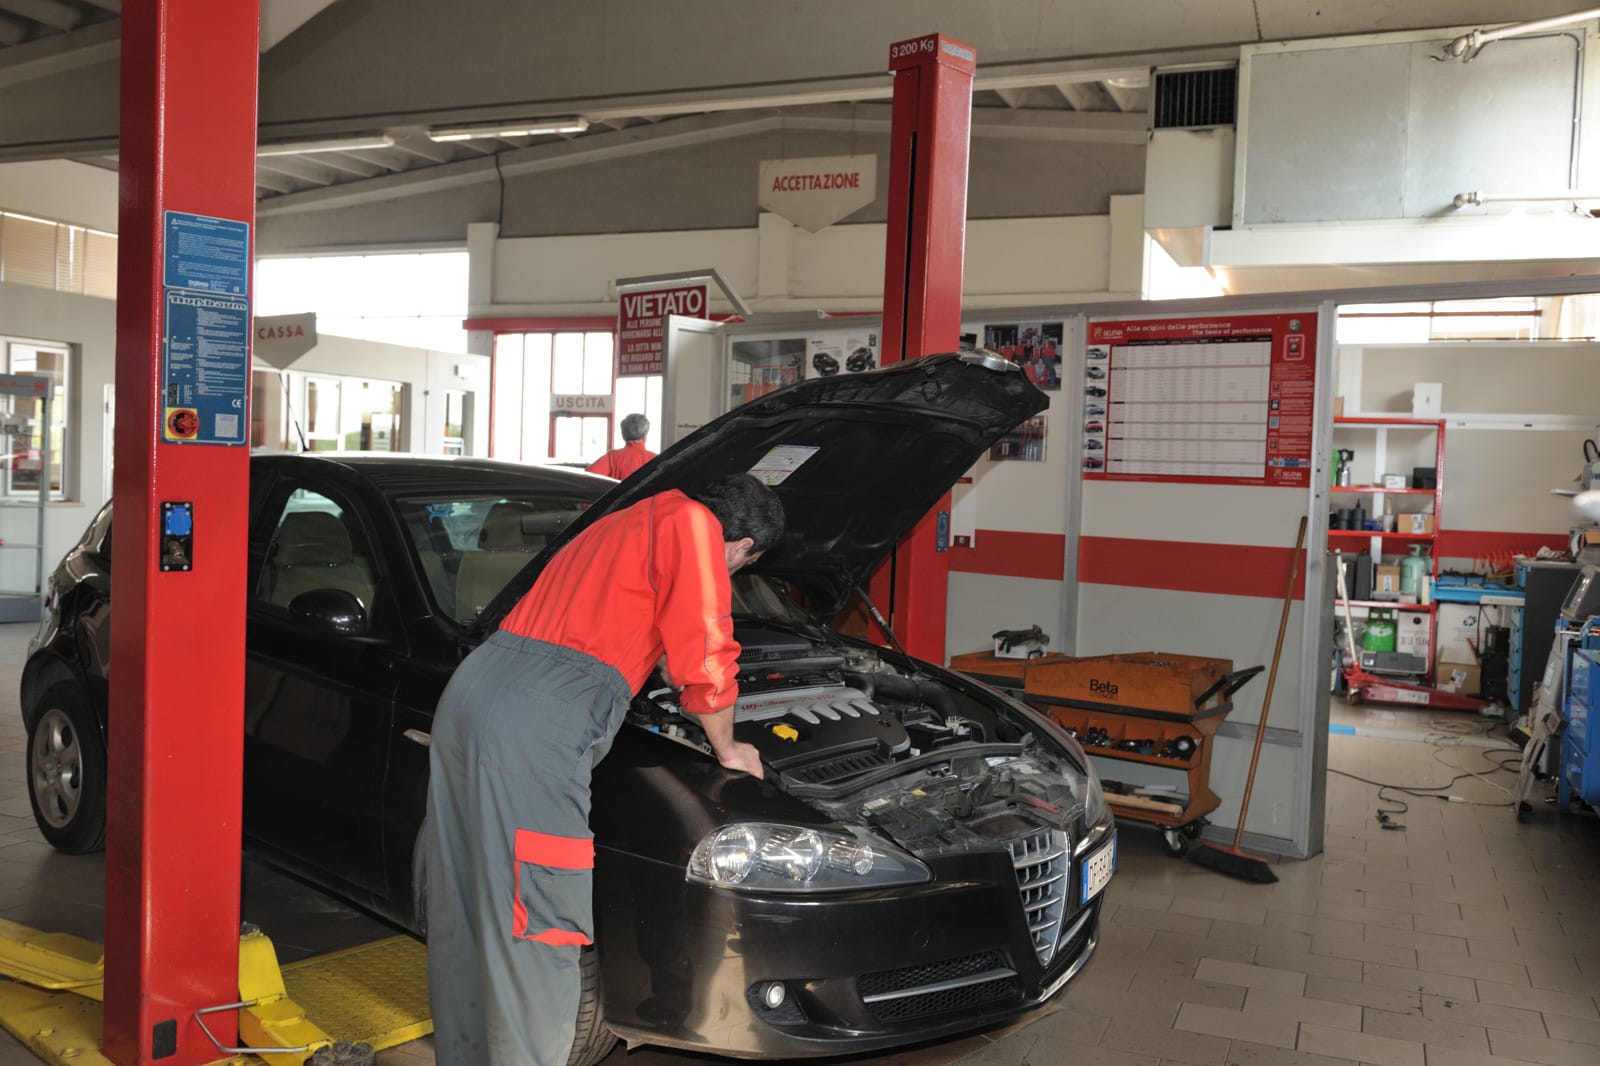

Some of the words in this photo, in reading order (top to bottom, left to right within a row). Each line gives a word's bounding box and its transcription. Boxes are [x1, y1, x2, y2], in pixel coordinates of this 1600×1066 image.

[920, 39, 935, 52] Kg
[772, 172, 860, 192] ACCETTAZIONE
[624, 289, 702, 318] VIETATO
[258, 324, 304, 340] CASSA
[1187, 321, 1231, 331] performance
[556, 397, 605, 408] USCITA
[1089, 678, 1118, 695] Beta
